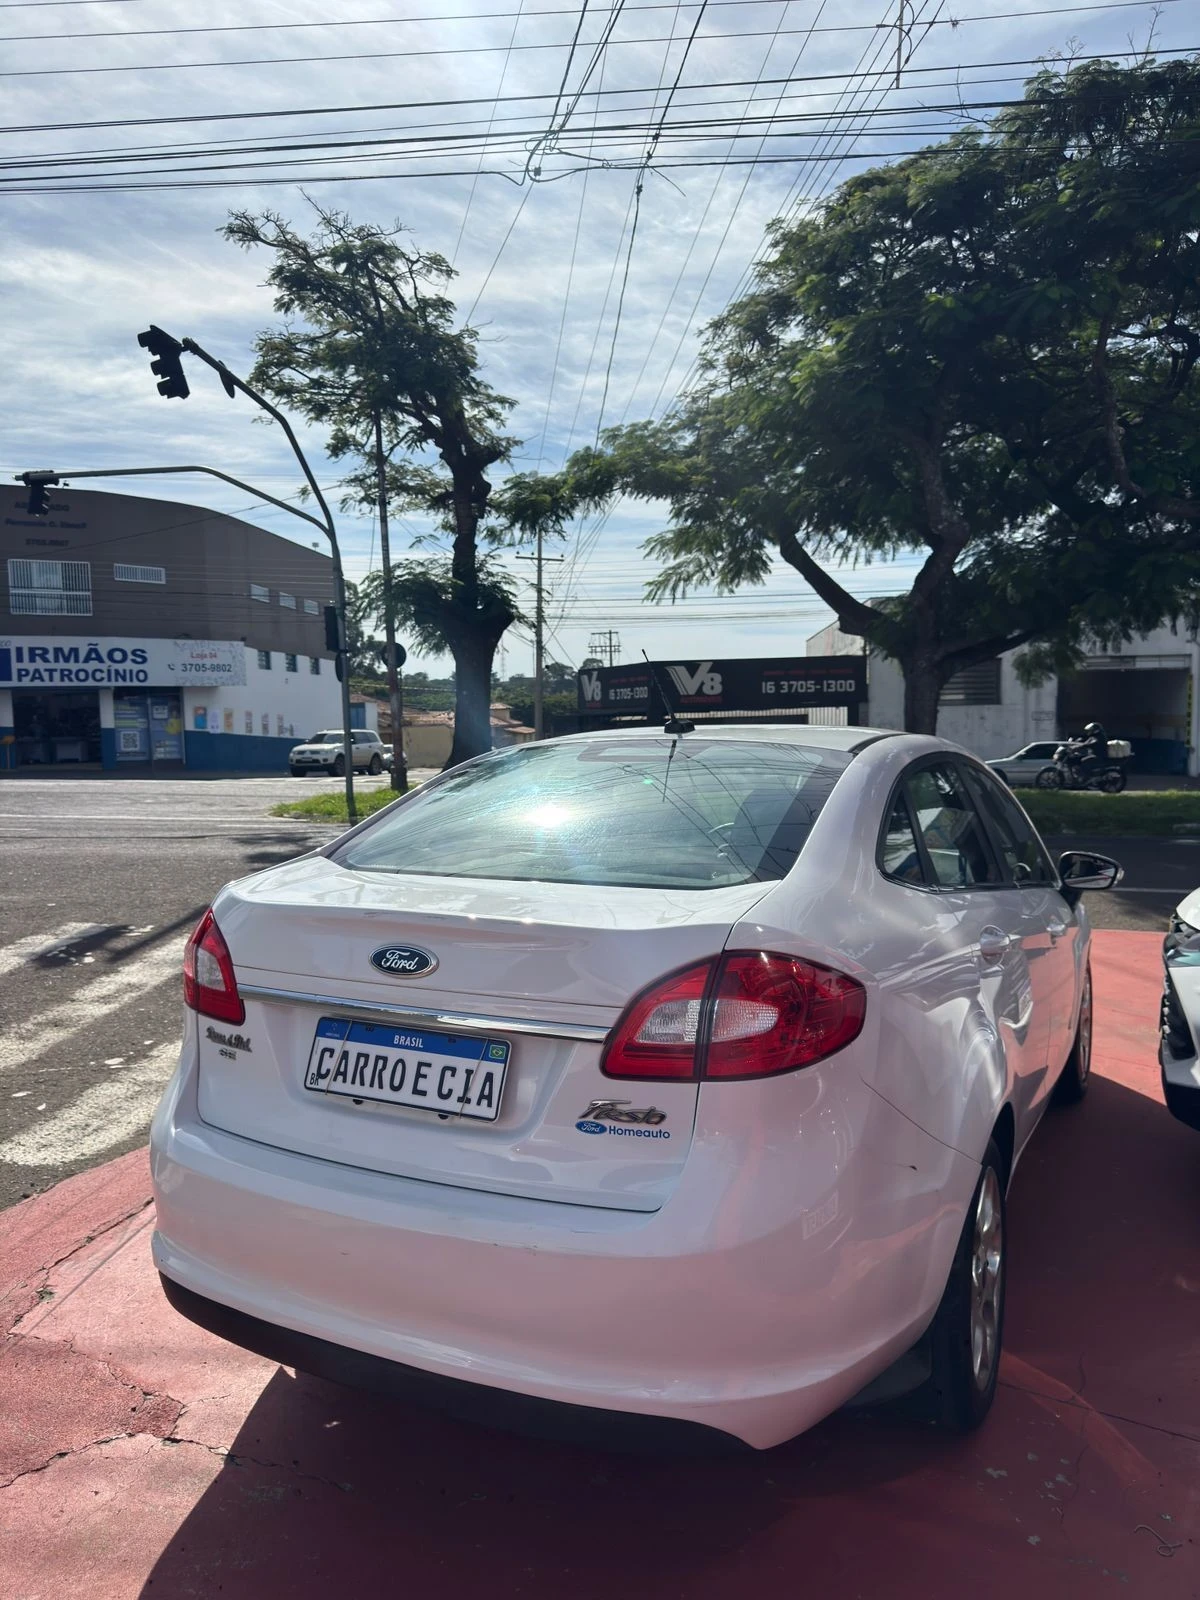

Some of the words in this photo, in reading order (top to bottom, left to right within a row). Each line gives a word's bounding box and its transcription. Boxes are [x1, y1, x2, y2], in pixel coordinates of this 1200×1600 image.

[15, 643, 148, 665] IRMÃOS
[17, 665, 148, 682] PATROCÍNIO
[181, 663, 232, 673] 3705-9802
[580, 670, 602, 702] V8
[664, 661, 723, 695] V8
[616, 686, 648, 700] 3705-1300
[762, 681, 775, 694] 16
[780, 680, 855, 694] 3705-1300
[381, 949, 419, 970] Ford
[393, 1035, 424, 1048] BRASIL
[309, 1073, 319, 1086] BR
[580, 1122, 601, 1133] Ford
[608, 1126, 671, 1139] Homeauto
